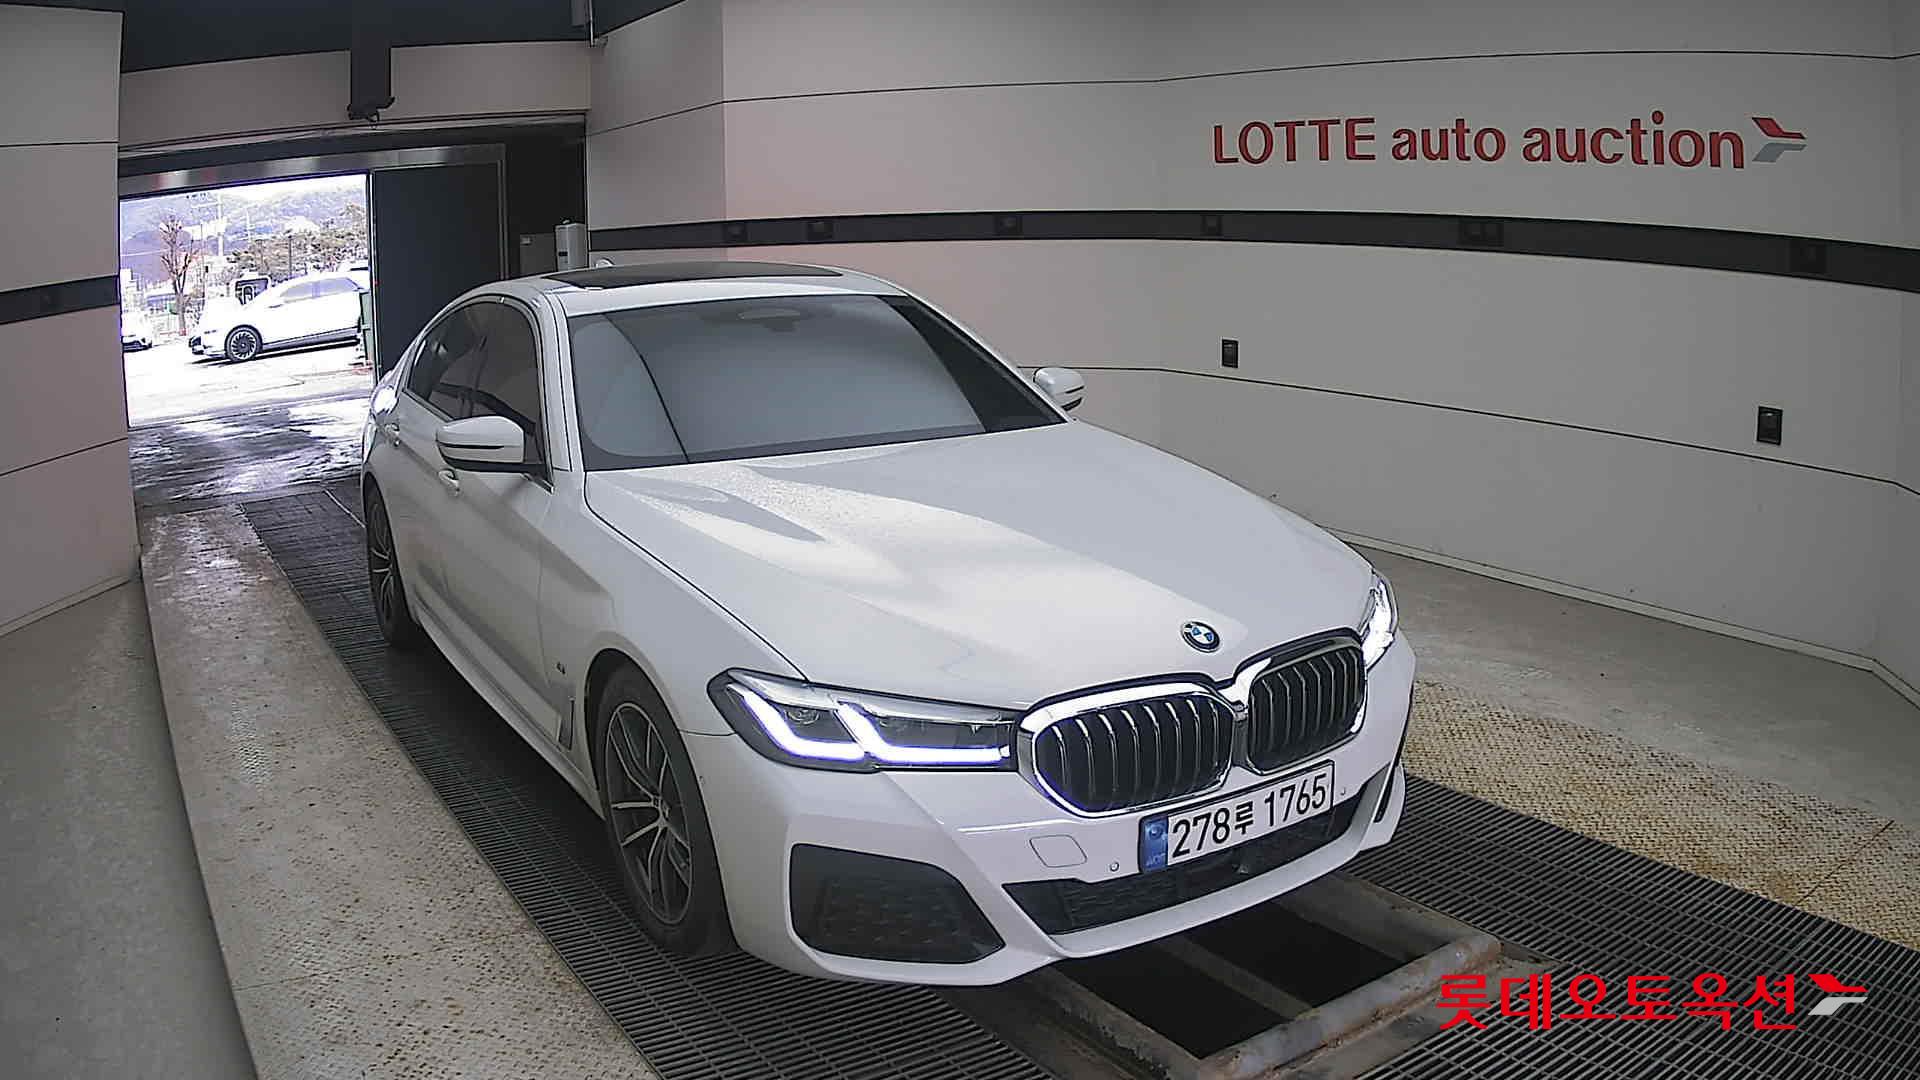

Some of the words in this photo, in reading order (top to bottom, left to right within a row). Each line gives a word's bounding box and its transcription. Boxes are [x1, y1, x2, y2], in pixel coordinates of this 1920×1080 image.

[1213, 117, 1376, 164] LOTTE
[1391, 117, 1506, 162] auto
[1522, 110, 1745, 169] auction
[1171, 801, 1254, 859] 278루
[1264, 773, 1328, 827] 1765
